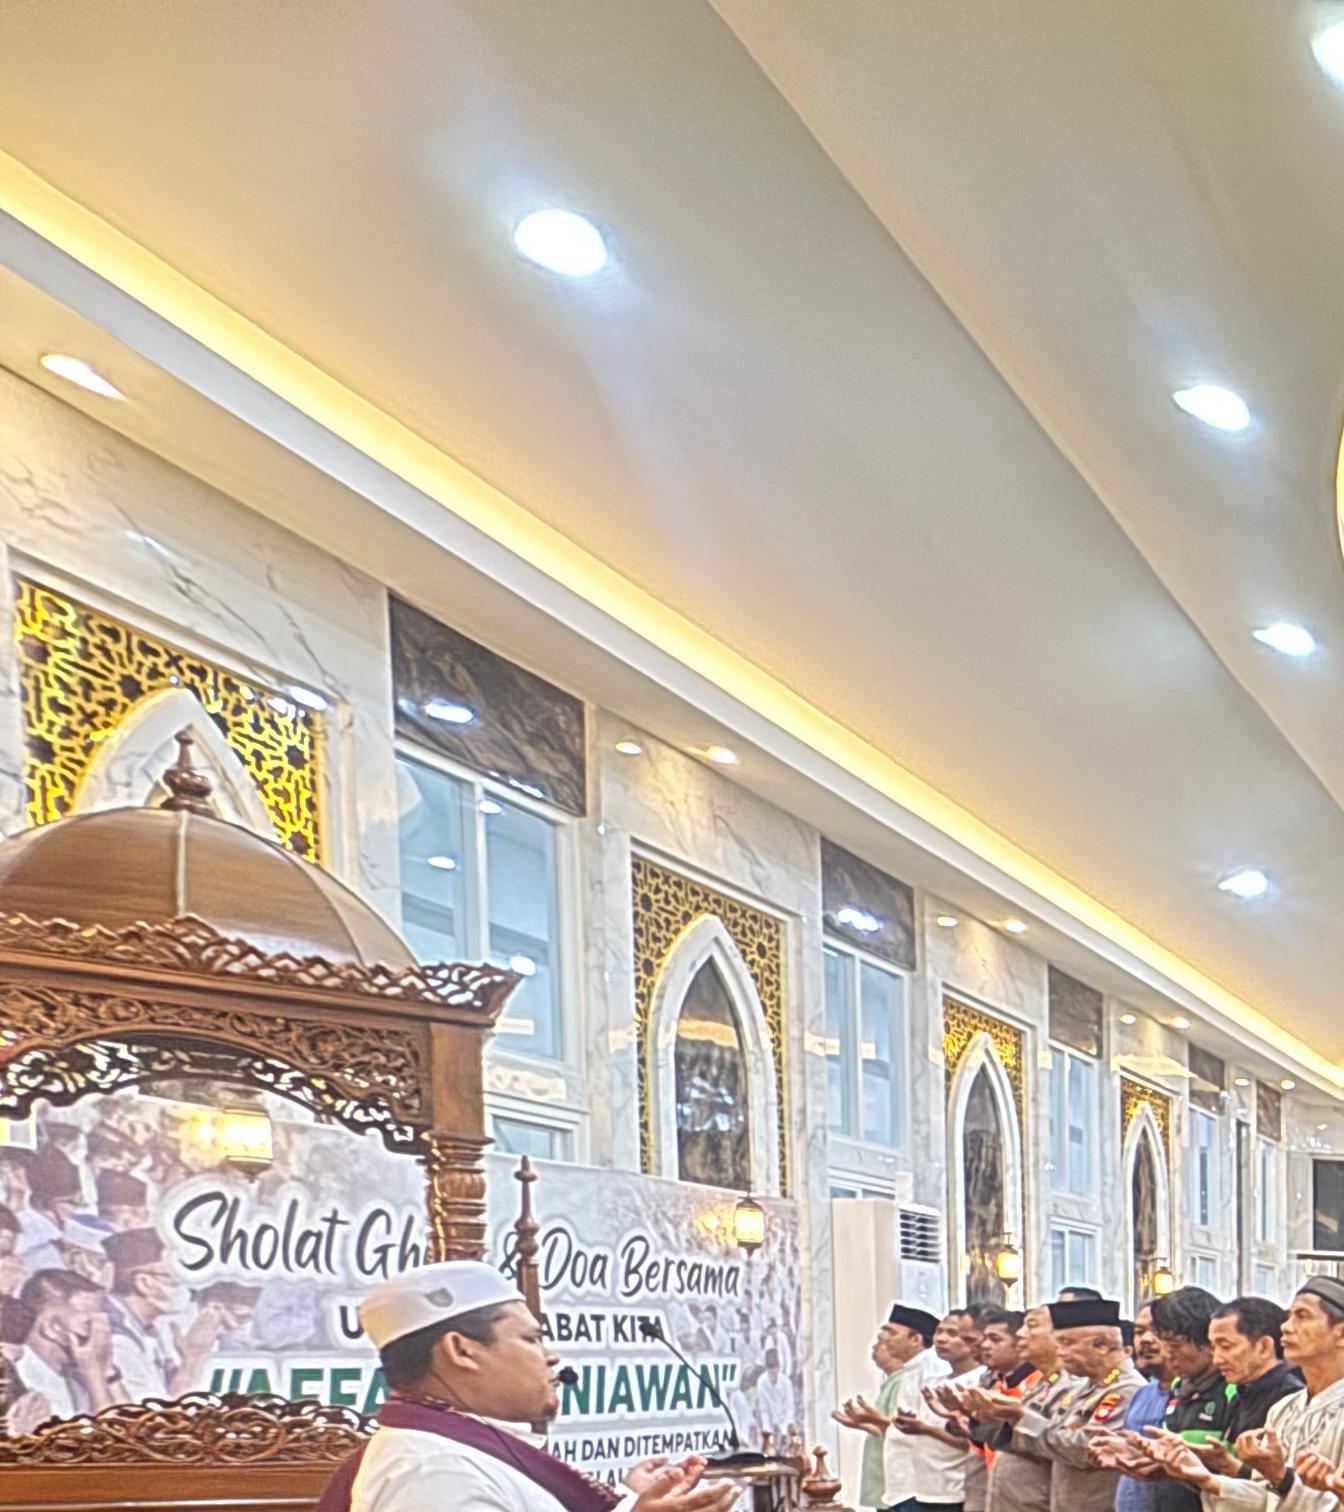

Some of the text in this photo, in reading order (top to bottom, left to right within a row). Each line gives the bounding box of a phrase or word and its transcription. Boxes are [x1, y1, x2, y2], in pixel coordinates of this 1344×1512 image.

[174, 1190, 350, 1276] Sholat
[538, 1226, 609, 1290] Doa
[620, 1235, 740, 1297] Bersama
[613, 1314, 663, 1343] KITA
[581, 1437, 620, 1461] DAN
[623, 1429, 734, 1457] DITEMPATKAN
